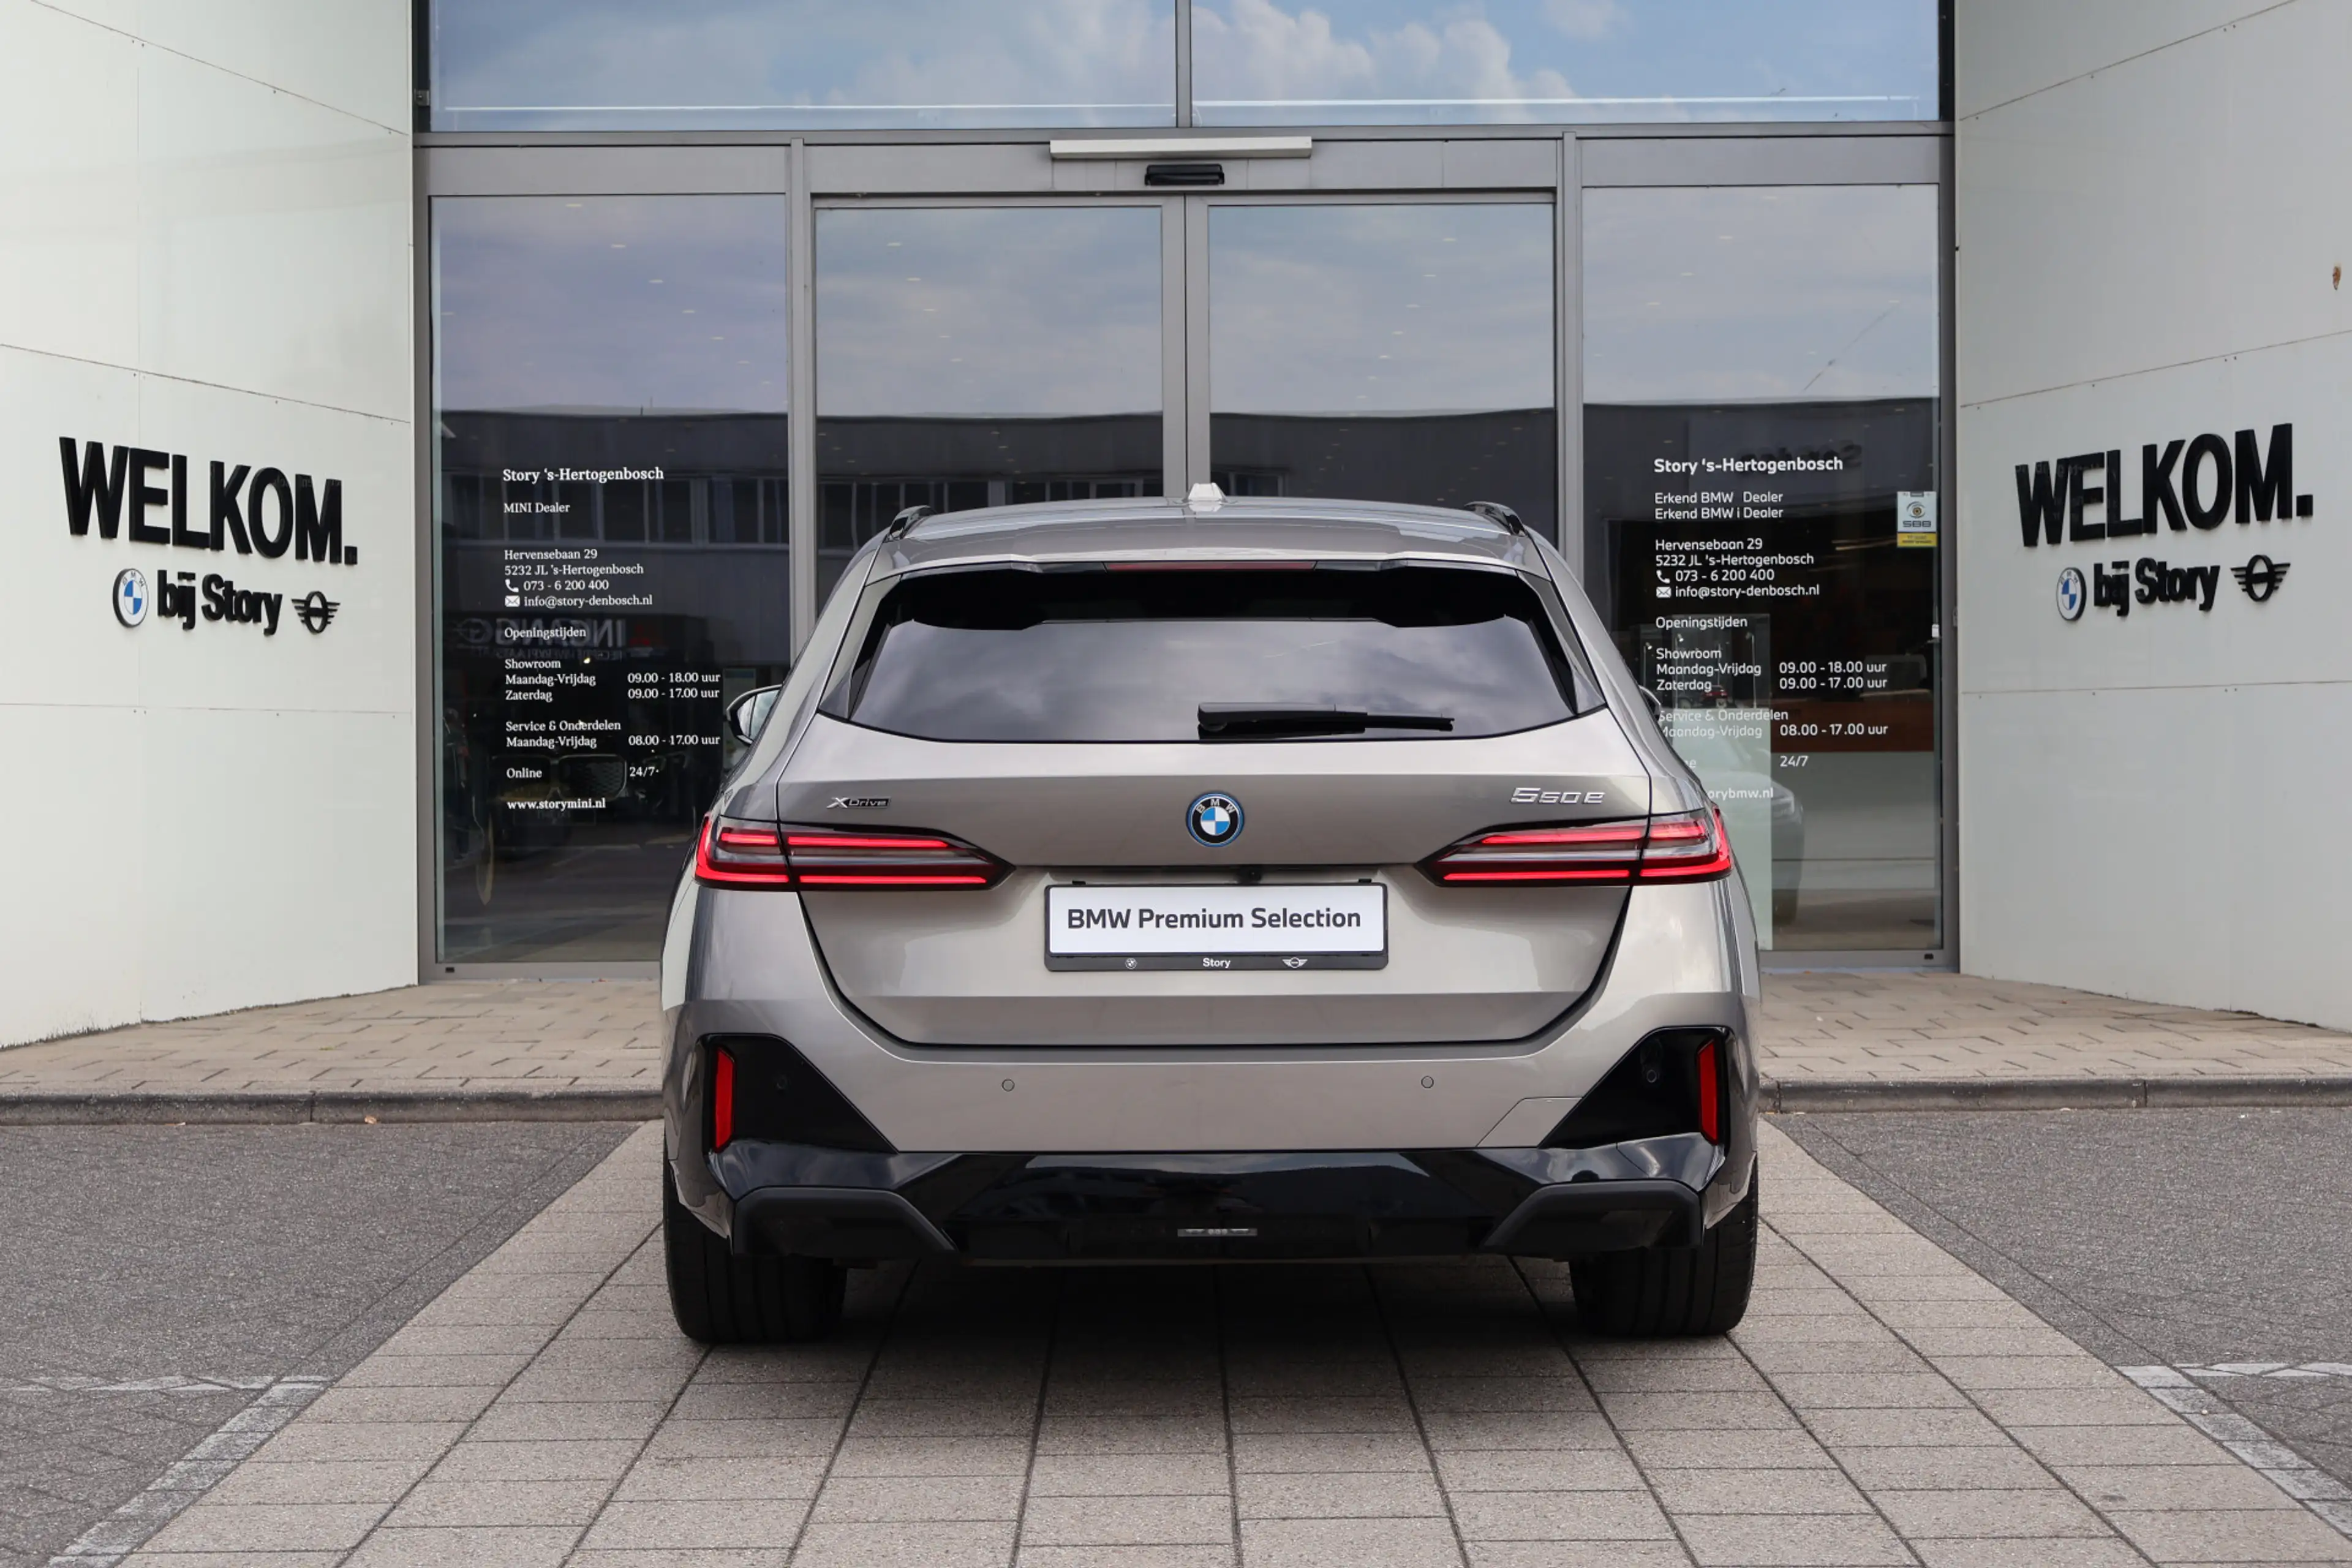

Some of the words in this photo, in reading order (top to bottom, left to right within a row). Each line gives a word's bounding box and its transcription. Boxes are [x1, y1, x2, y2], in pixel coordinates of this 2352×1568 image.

[1654, 459, 1697, 475] Story
[503, 469, 540, 484] Story
[2015, 423, 2313, 547] WELKOM.
[59, 436, 358, 565] WELKOM.
[1656, 492, 1697, 503] Erkend
[1702, 492, 1733, 502] BMW
[1744, 492, 1782, 502] Dealer
[505, 503, 530, 512] MINI
[536, 502, 570, 512] Dealer
[1656, 508, 1697, 519] Erkend
[1702, 508, 1733, 518] BMW
[1737, 507, 1740, 518] i
[1744, 507, 1783, 518] Dealer
[1656, 539, 1743, 550] Hervensebaan
[1747, 538, 1762, 549] 29
[505, 549, 580, 559] Hervensebaan
[584, 549, 597, 559] 29
[1656, 555, 1685, 566] 5232
[1689, 555, 1702, 567] JL
[505, 565, 531, 575] 5232
[535, 565, 548, 575] JL
[1676, 570, 1697, 581] 073
[1711, 570, 1717, 581] 6
[1722, 570, 1746, 580] 200
[1750, 569, 1774, 580] 400
[524, 581, 544, 590] 073
[555, 581, 561, 590] 6
[565, 581, 585, 590] 200
[589, 580, 608, 589] 400
[1676, 584, 1819, 599] info@story-denbosch.nl
[2094, 560, 2130, 617] bij
[2135, 557, 2220, 611] Story
[157, 570, 195, 630] bij
[202, 573, 283, 635] Story
[525, 595, 652, 608] info@story-denbosch.nl
[1656, 617, 1747, 630] Openingstijden
[505, 627, 586, 640] Openingstijden
[1657, 648, 1721, 658] Showroom
[505, 659, 560, 668] Showroom
[1657, 663, 1761, 676] Maandag-Vrijdag
[1780, 662, 1815, 673] 09.00
[1828, 662, 1862, 673] 18.00
[506, 674, 595, 686] Maandag-Vrijdag
[628, 673, 658, 682] 09.00
[670, 673, 698, 682] 18.00
[1657, 680, 1711, 692] Zaterdag
[1780, 677, 1816, 689] 09.00
[506, 690, 552, 702] Zaterdag
[628, 689, 658, 698] 09.00
[671, 688, 698, 698] 17.00
[1659, 710, 1702, 722] Service
[1704, 710, 1716, 722] &
[1718, 709, 1789, 722] Onderdelen
[507, 722, 545, 731] Service
[549, 721, 556, 730] &
[560, 720, 620, 730] Onderdelen
[1662, 725, 1763, 739] Maandag-Vrijdag
[1781, 725, 1817, 735] 08.00
[507, 736, 596, 748] Maandag-Vrijdag
[629, 736, 658, 745] 08.00
[671, 735, 698, 744] 17.00
[1781, 756, 1807, 766] 24/7
[507, 768, 541, 778] Online
[1708, 786, 1773, 801] orybmw.nl
[508, 798, 605, 811] www.storymini.nl
[1195, 798, 1236, 813] BMW
[1069, 909, 1131, 928] BMW
[1139, 908, 1243, 928] Premium
[1251, 908, 1360, 927] Selection
[1203, 958, 1231, 968] Story
